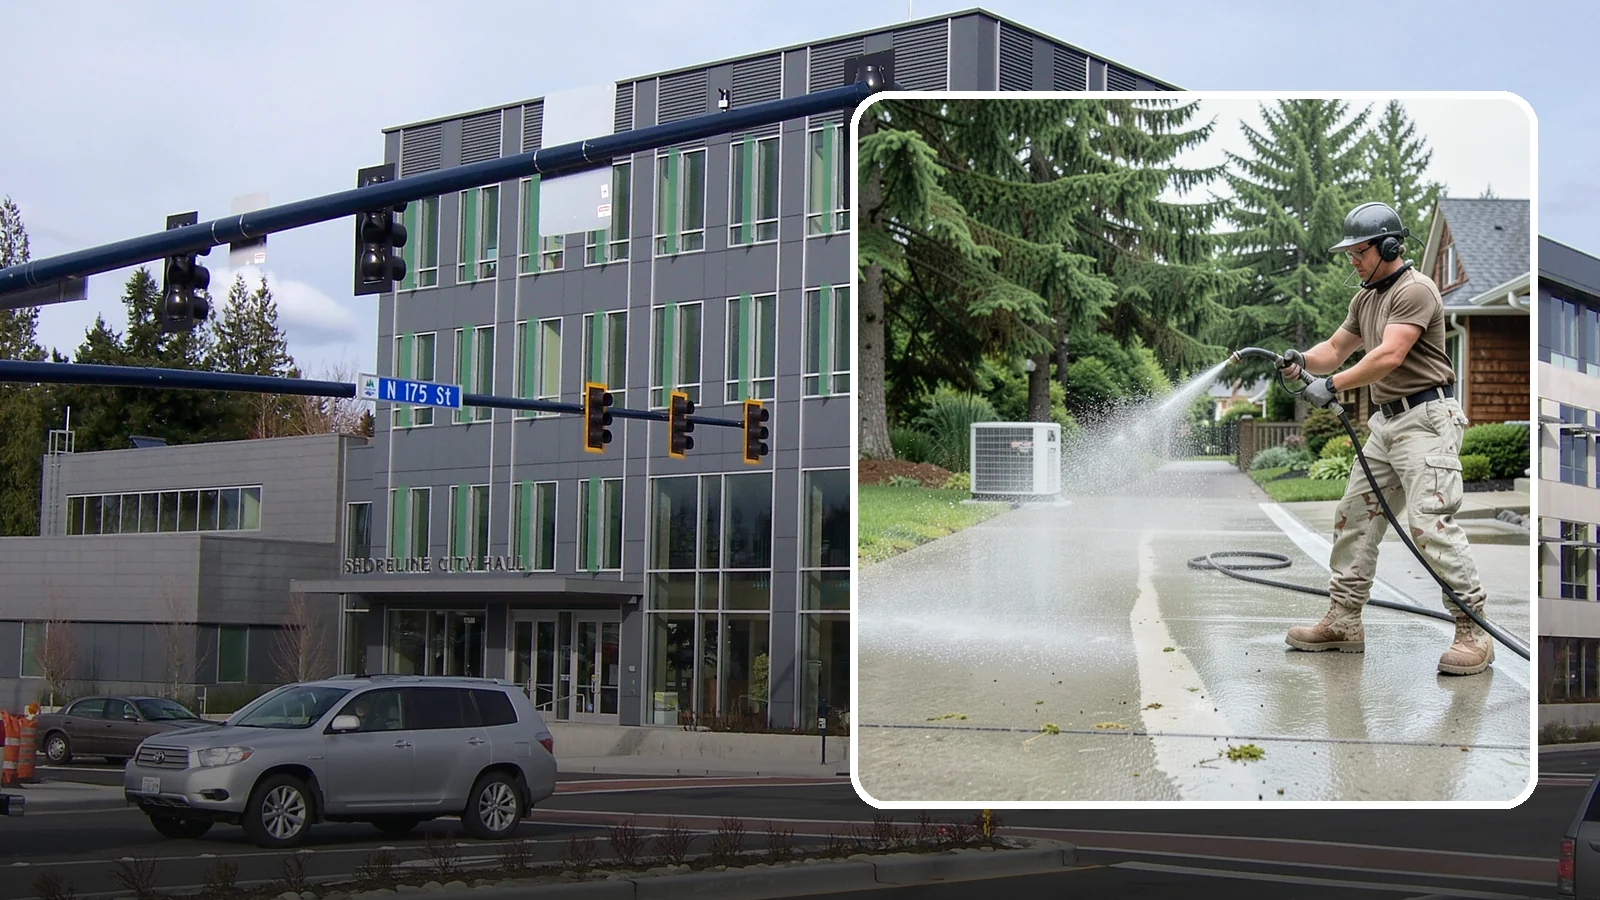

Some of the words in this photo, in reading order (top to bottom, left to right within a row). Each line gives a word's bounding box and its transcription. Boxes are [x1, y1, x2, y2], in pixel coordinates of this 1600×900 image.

[387, 381, 396, 400] N
[405, 383, 427, 403] 175
[436, 387, 451, 406] St
[344, 557, 432, 574] SHORELINE
[438, 556, 476, 573] CITY
[484, 555, 526, 572] HALL
